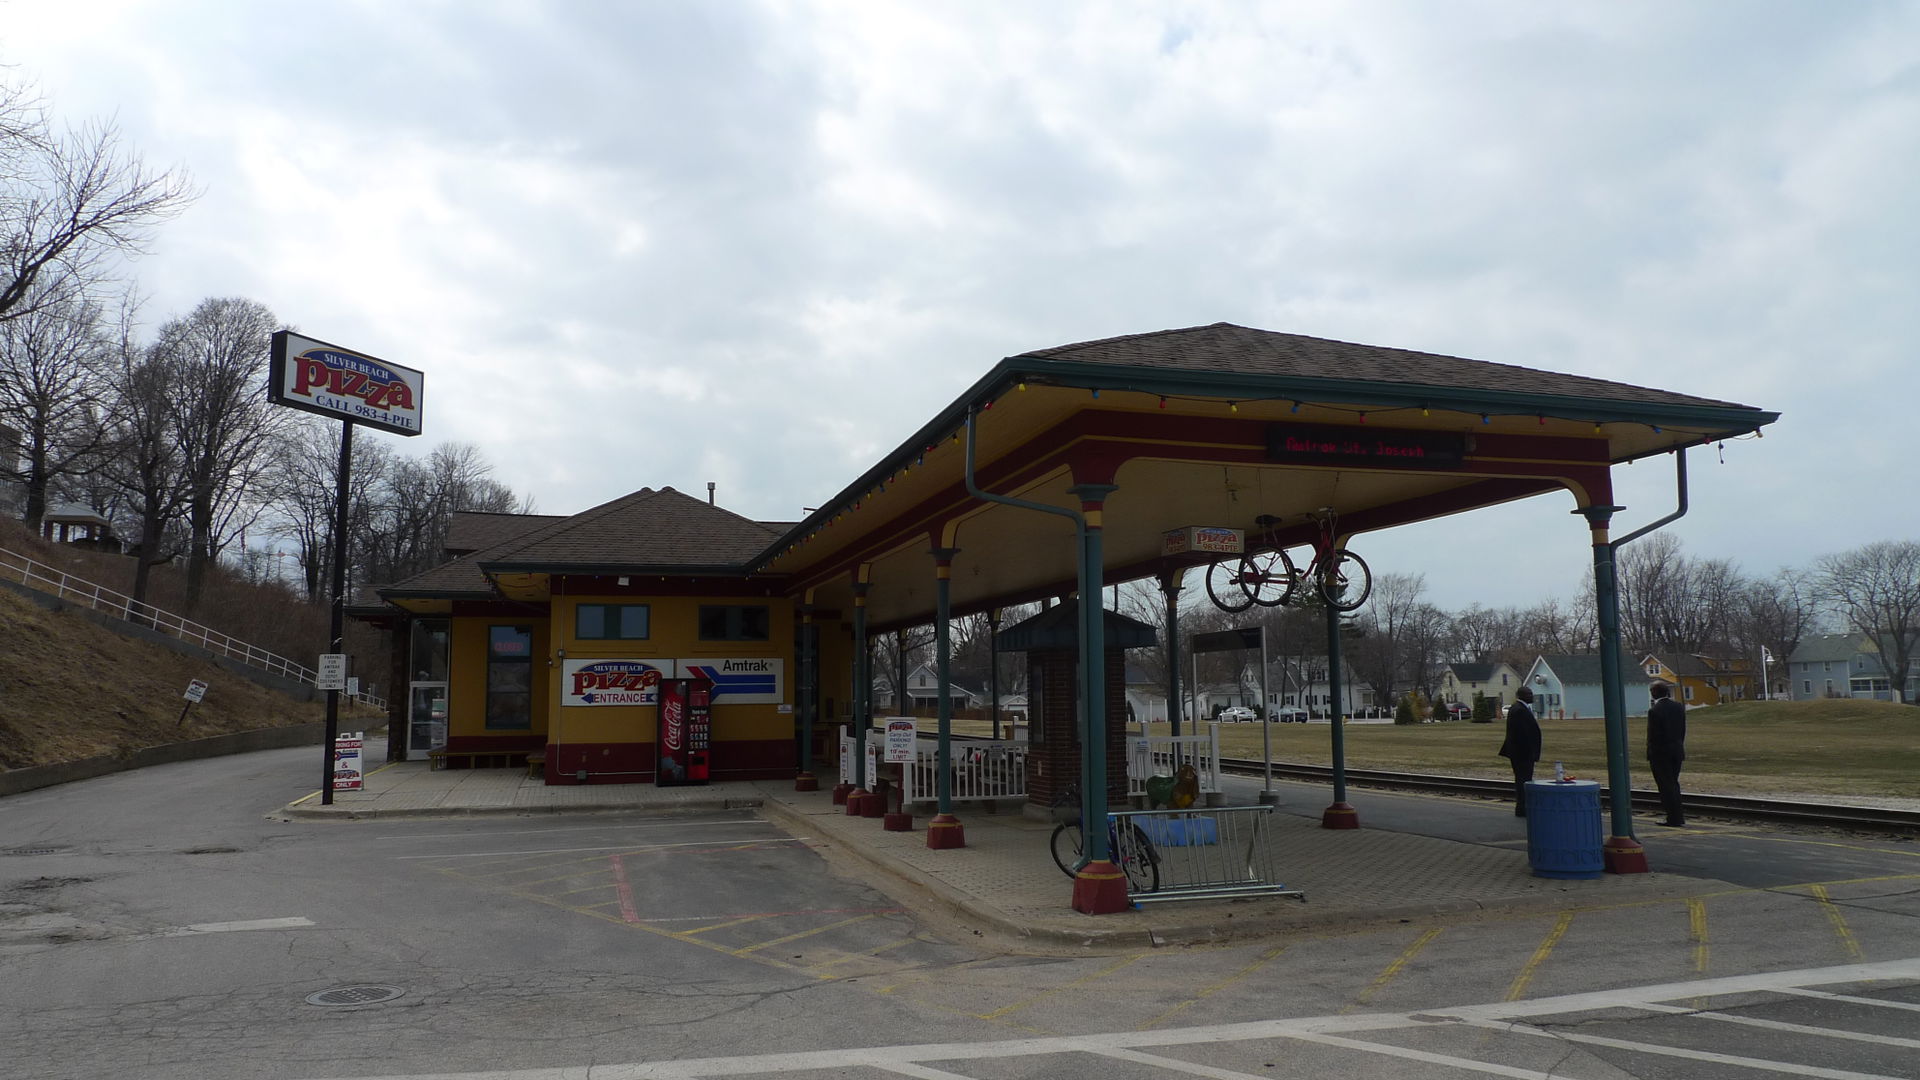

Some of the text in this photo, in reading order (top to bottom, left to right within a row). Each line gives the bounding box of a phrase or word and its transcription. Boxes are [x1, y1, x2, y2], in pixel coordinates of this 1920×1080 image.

[324, 352, 389, 380] SILVER BEACH
[316, 394, 413, 429] CALL 983-4-PIE
[593, 693, 646, 704] ENTRANCE
